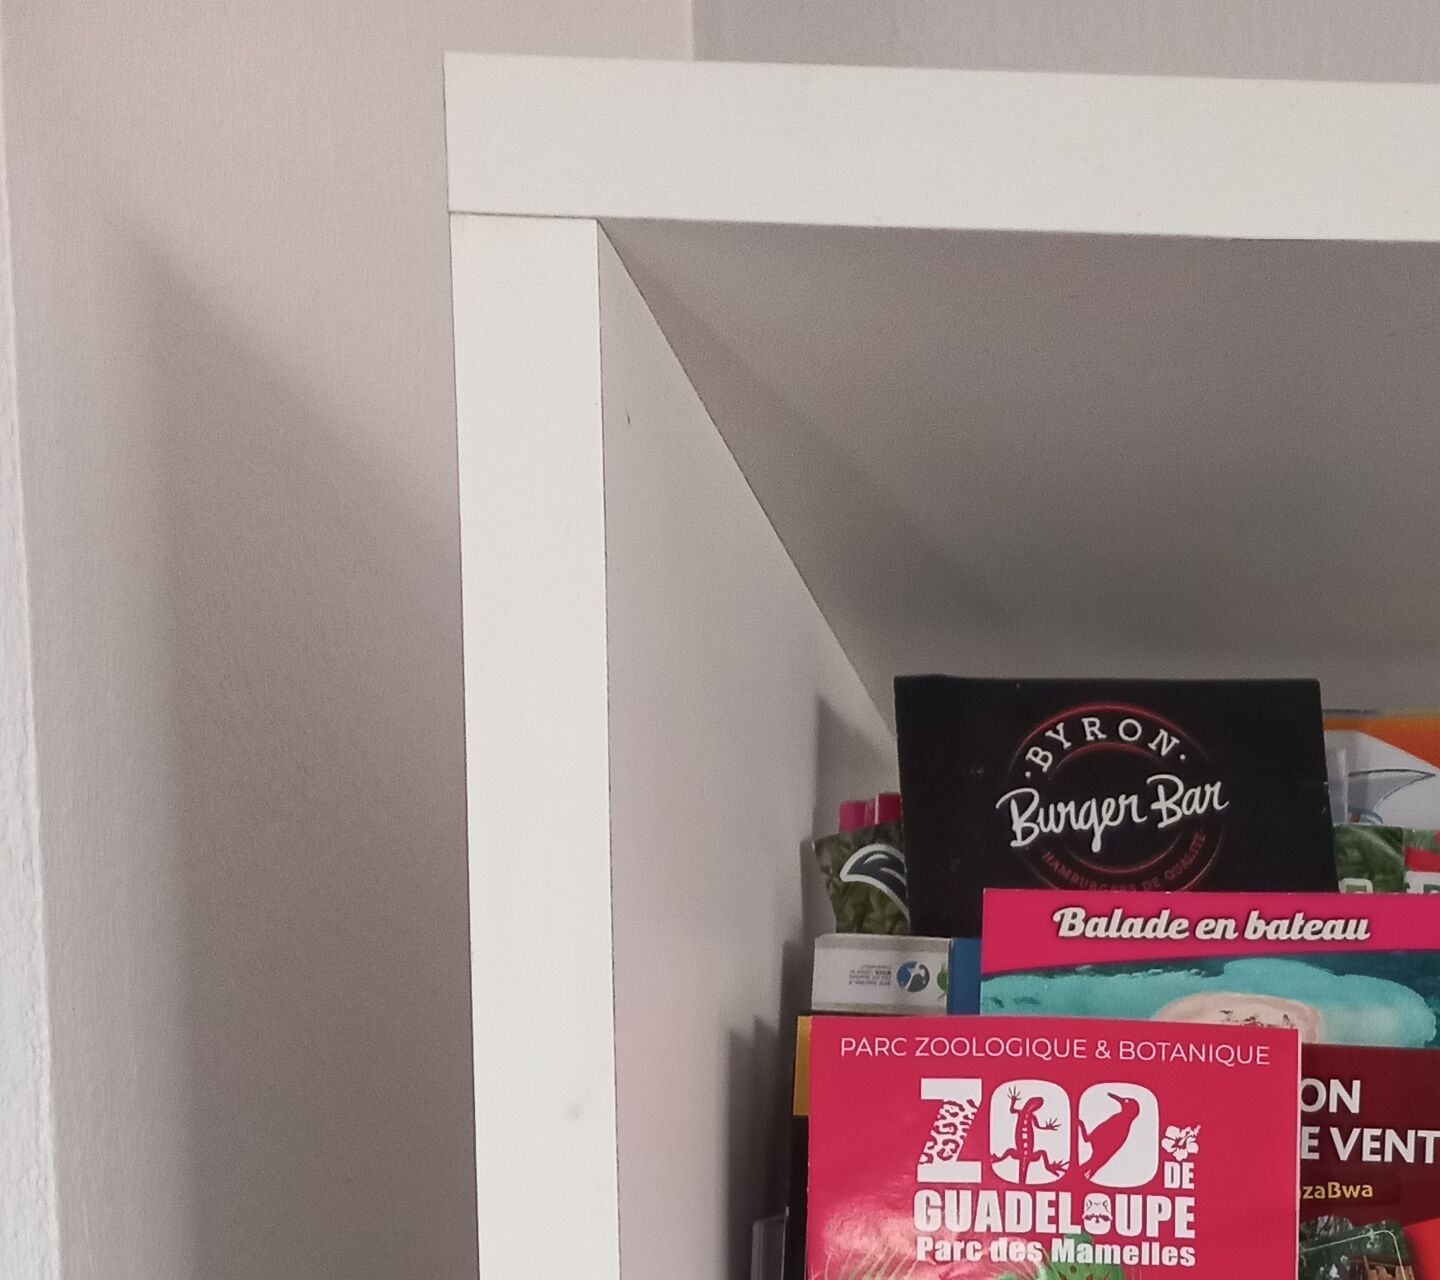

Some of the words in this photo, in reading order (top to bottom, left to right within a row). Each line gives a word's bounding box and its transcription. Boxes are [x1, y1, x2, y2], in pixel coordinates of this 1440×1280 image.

[1025, 717, 1180, 772] BYRON
[996, 787, 1147, 853] Burger
[1146, 773, 1230, 828] Bar
[1053, 907, 1189, 939] Balade
[1195, 916, 1239, 940] en
[1244, 910, 1371, 941] bateau
[840, 1037, 907, 1057] PARC
[914, 1037, 1087, 1061] ZOOLOGIQUE
[1095, 1039, 1112, 1060] &
[1119, 1041, 1270, 1066] BOTANIQUE
[916, 1077, 1160, 1188] ZOO
[1163, 1161, 1195, 1190] DE
[913, 1189, 1195, 1239] GUADELOUPE
[916, 1238, 985, 1262] Parc
[990, 1238, 1043, 1262] des
[1051, 1238, 1195, 1267] Mamelles
